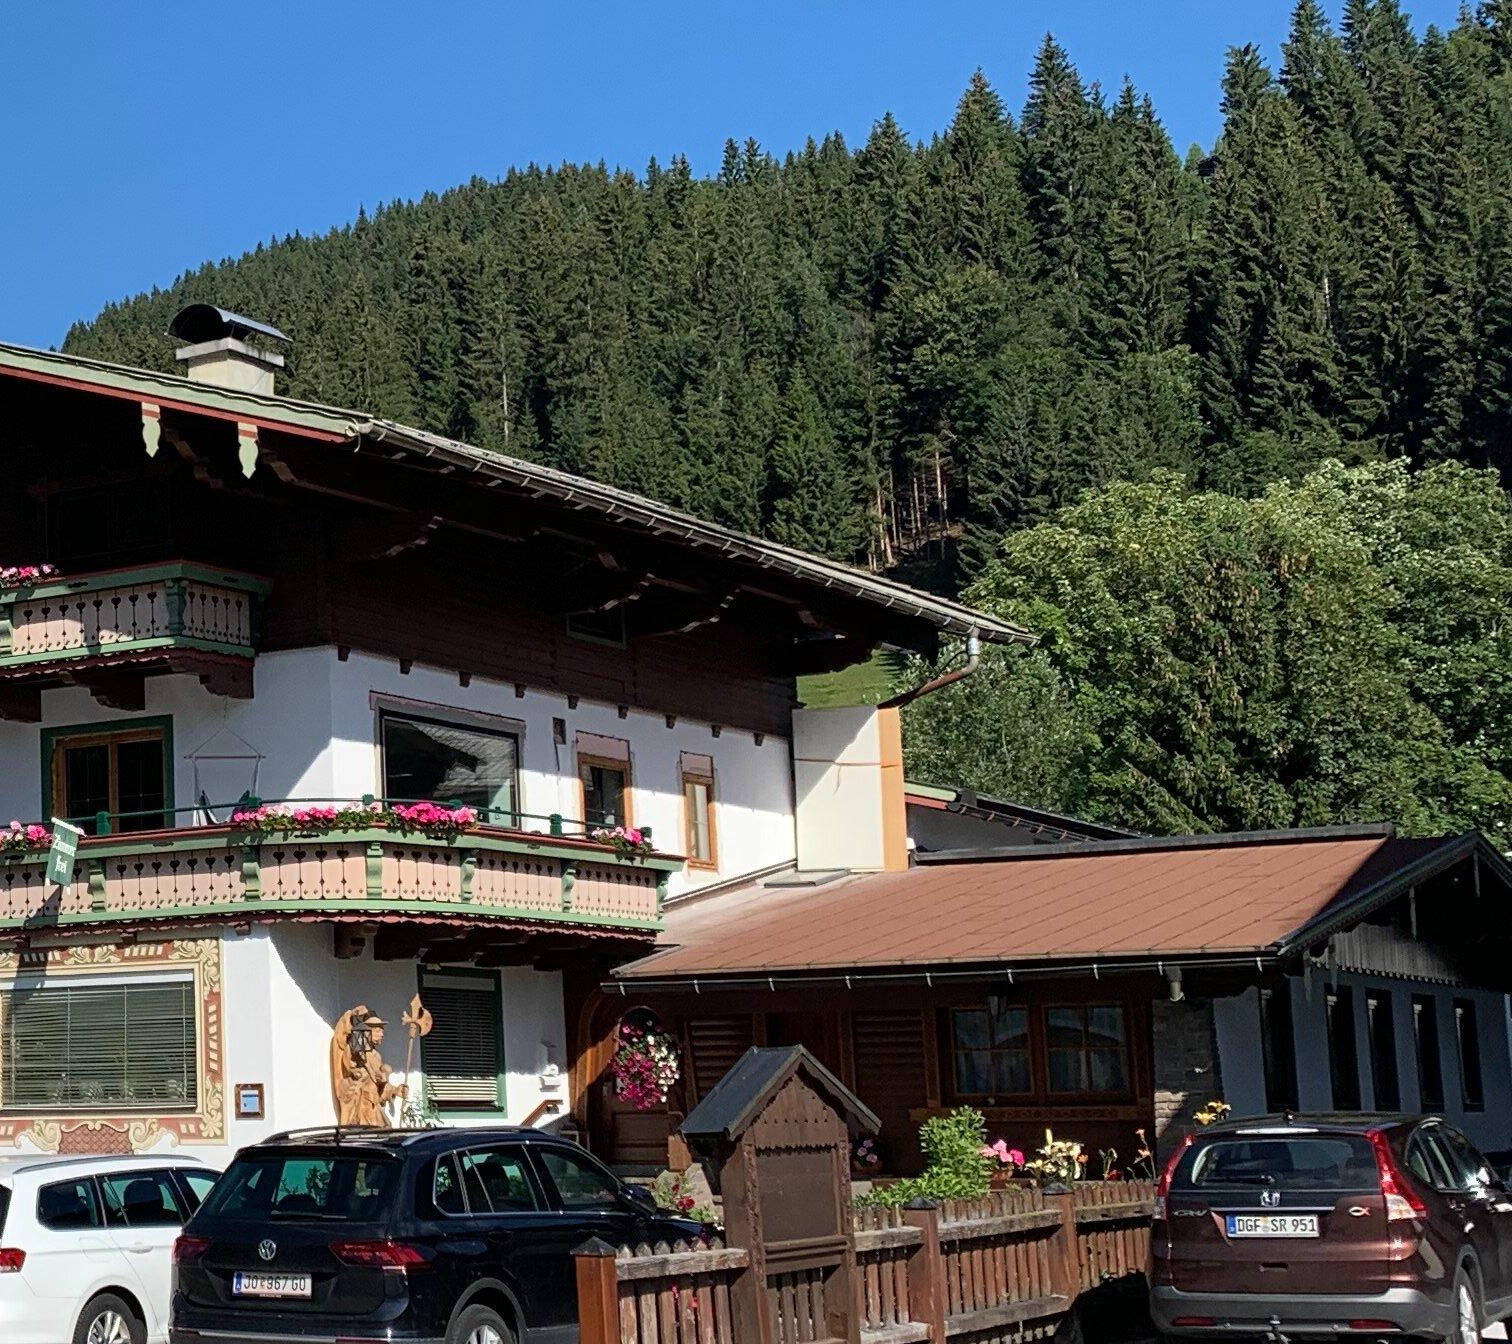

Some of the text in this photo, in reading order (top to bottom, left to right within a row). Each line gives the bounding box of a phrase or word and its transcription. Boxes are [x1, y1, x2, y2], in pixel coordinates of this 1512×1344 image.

[1237, 1218, 1316, 1232] DGF SR 951
[266, 1276, 288, 1290] 967
